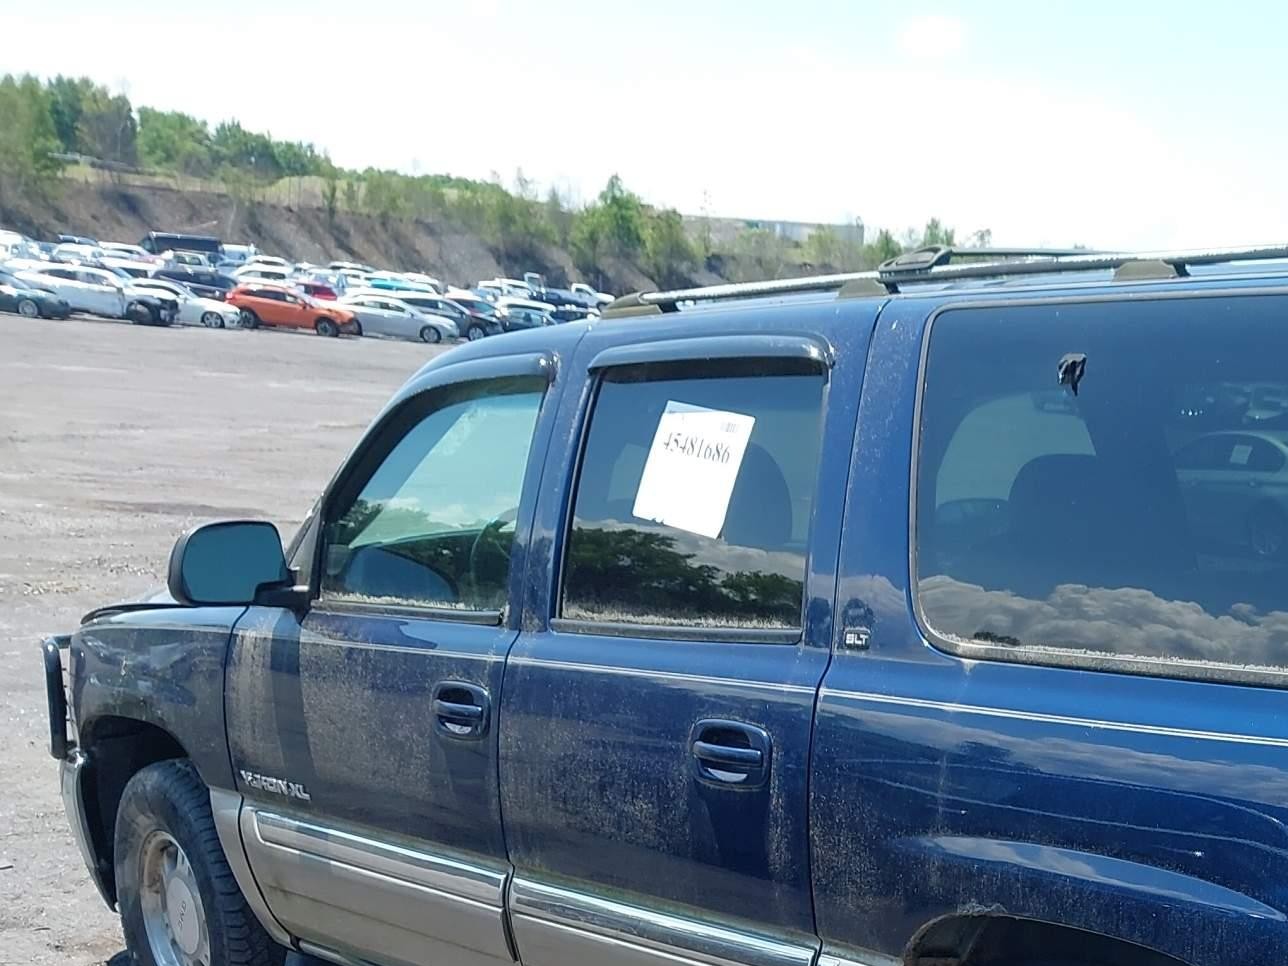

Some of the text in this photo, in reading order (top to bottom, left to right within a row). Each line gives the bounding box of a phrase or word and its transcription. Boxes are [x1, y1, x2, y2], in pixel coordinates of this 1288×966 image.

[663, 432, 731, 464] 45481686
[846, 633, 869, 645] SLT
[288, 782, 312, 801] XL
